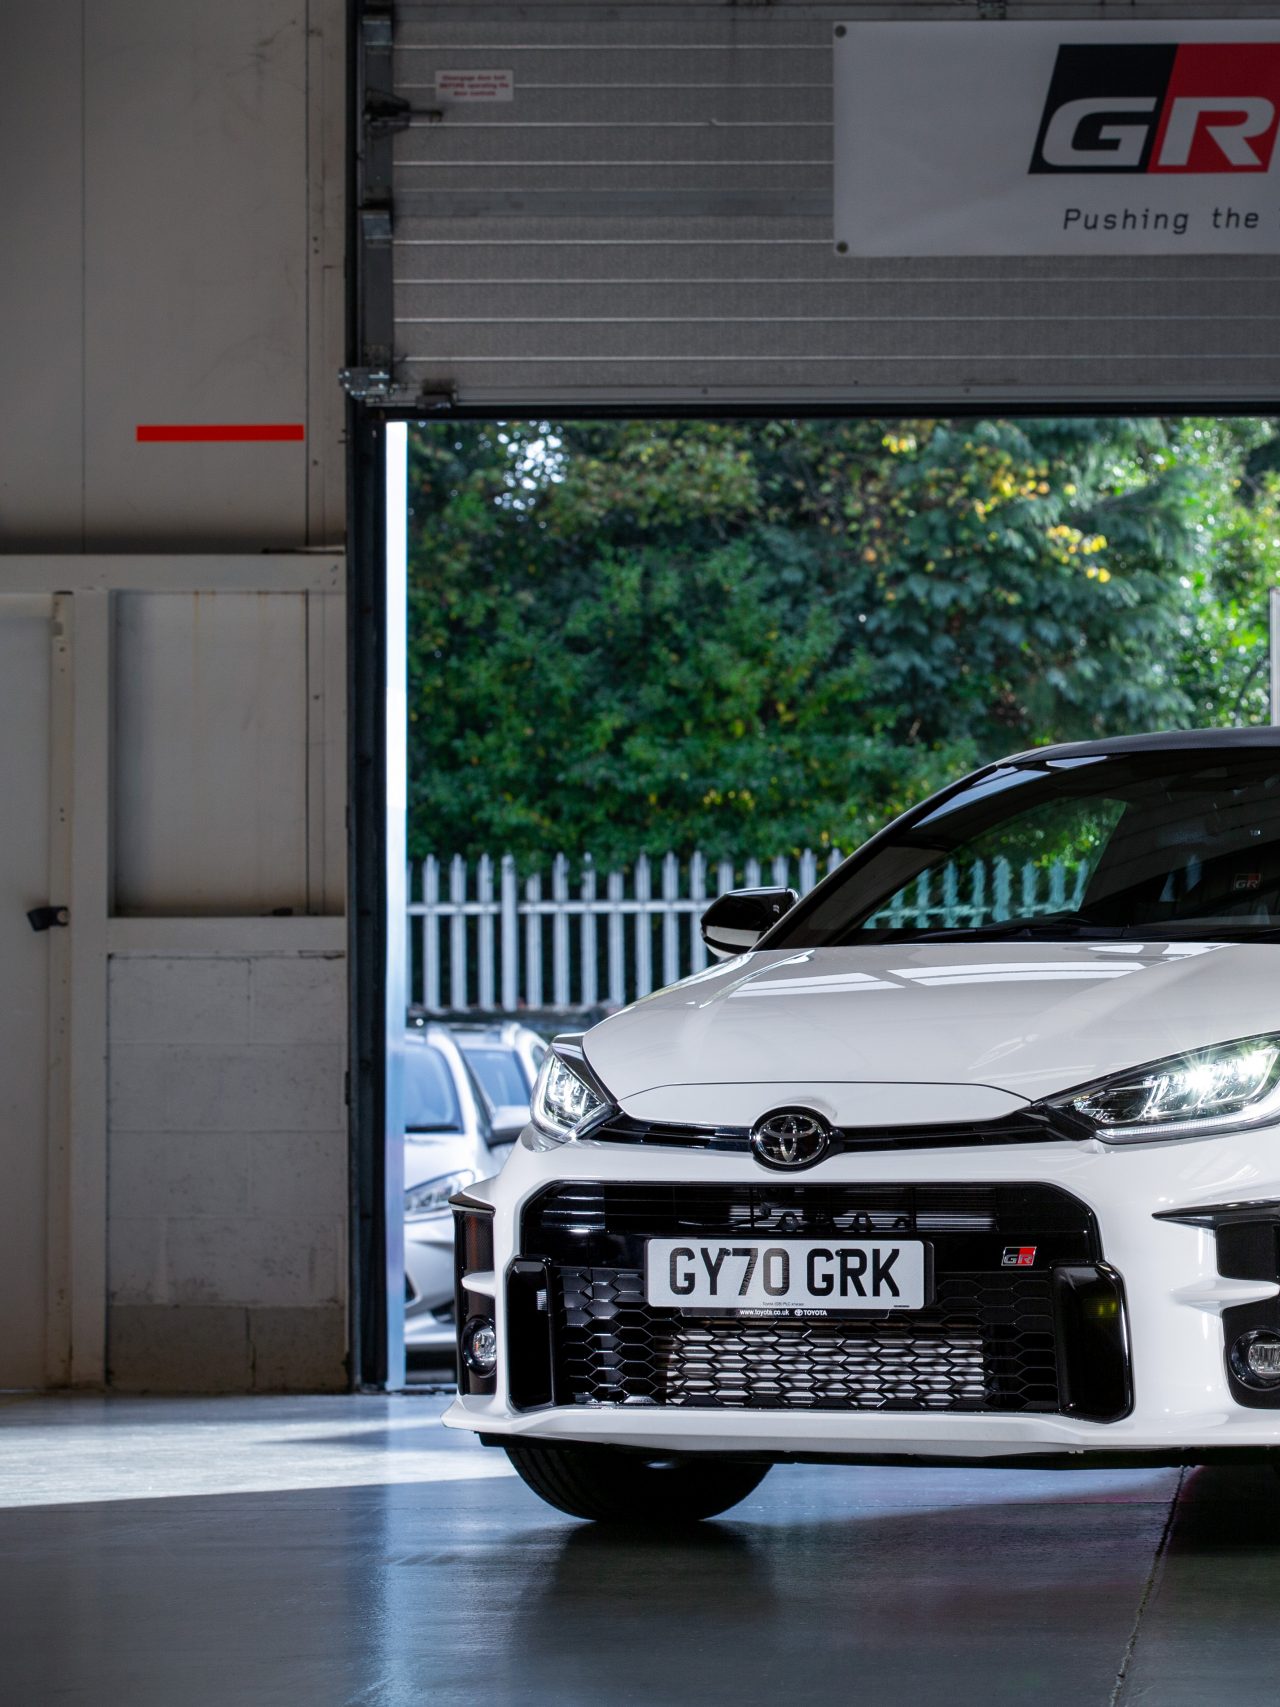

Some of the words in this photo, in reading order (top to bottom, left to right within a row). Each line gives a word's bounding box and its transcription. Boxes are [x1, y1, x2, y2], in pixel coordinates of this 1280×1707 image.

[1041, 97, 1276, 166] GR
[1063, 207, 1189, 235] Pushing
[1212, 207, 1260, 229] the
[669, 1247, 790, 1297] GY70
[806, 1248, 900, 1297] GRK
[740, 1309, 790, 1317] www.toyota.co.uk
